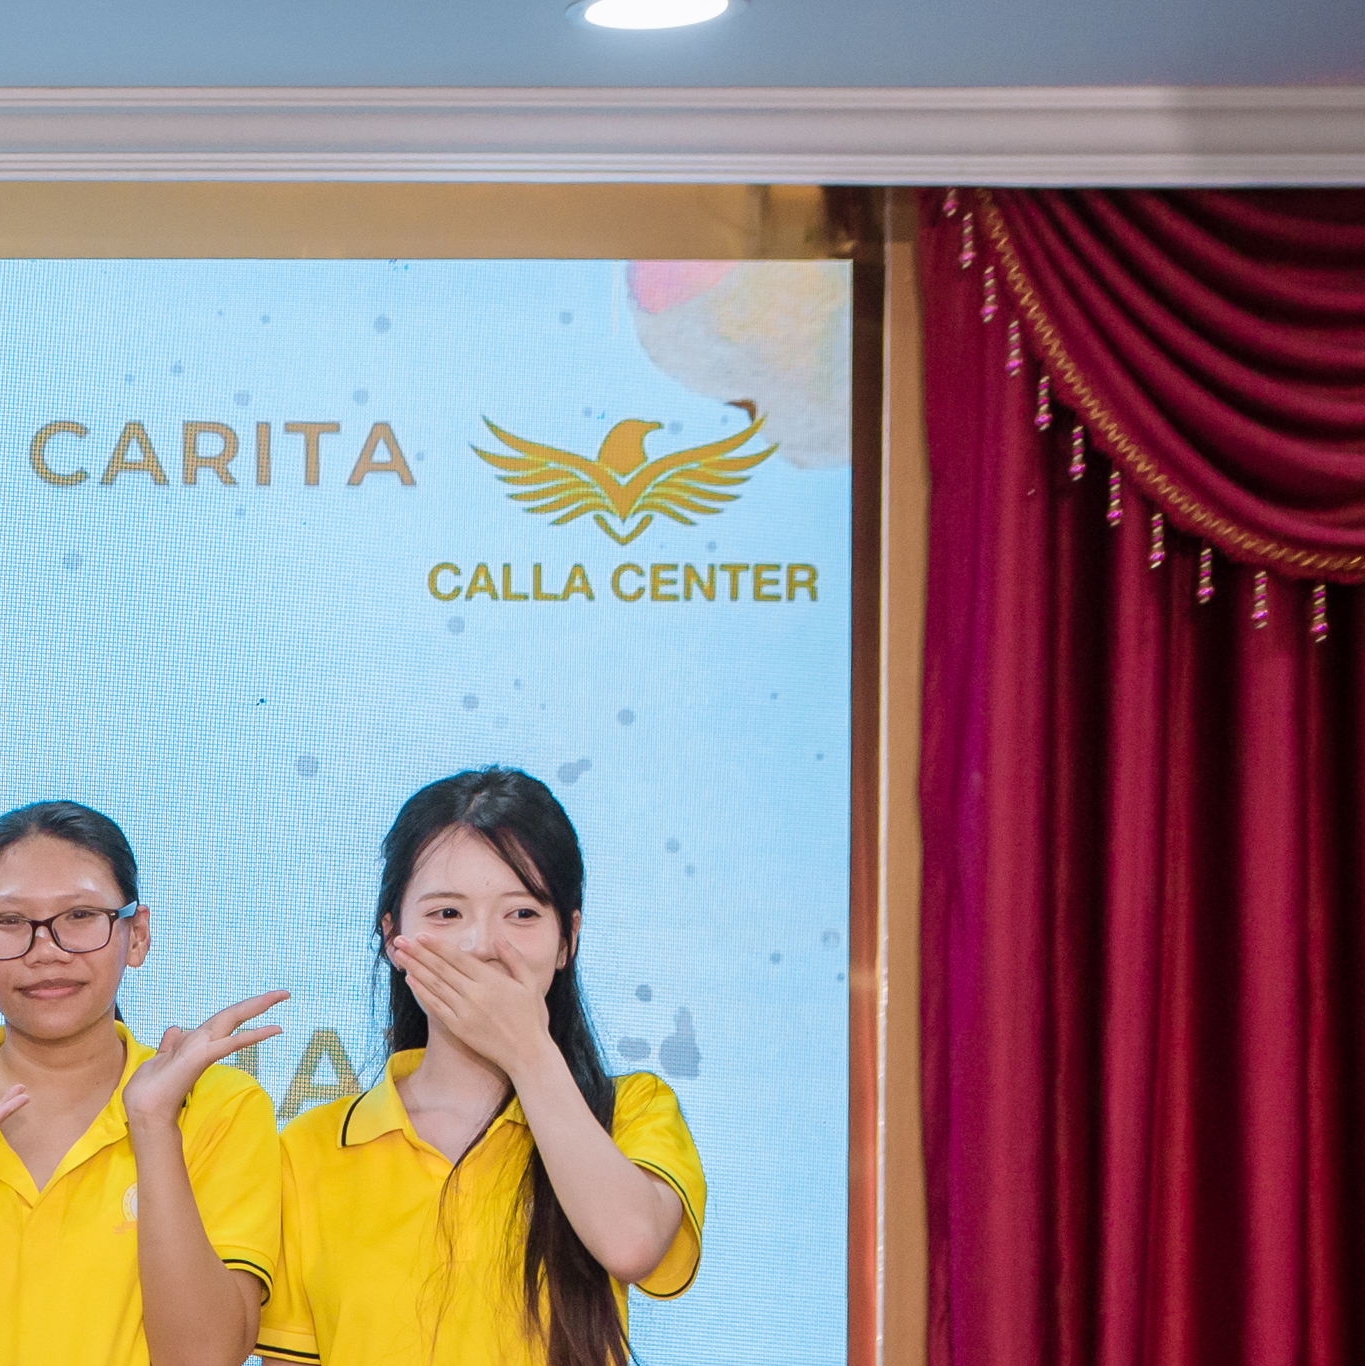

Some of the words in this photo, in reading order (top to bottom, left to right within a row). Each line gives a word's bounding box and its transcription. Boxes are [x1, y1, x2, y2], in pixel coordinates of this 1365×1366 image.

[28, 419, 417, 488] CARITA
[427, 562, 596, 602] CALLA
[611, 562, 819, 602] CENTER
